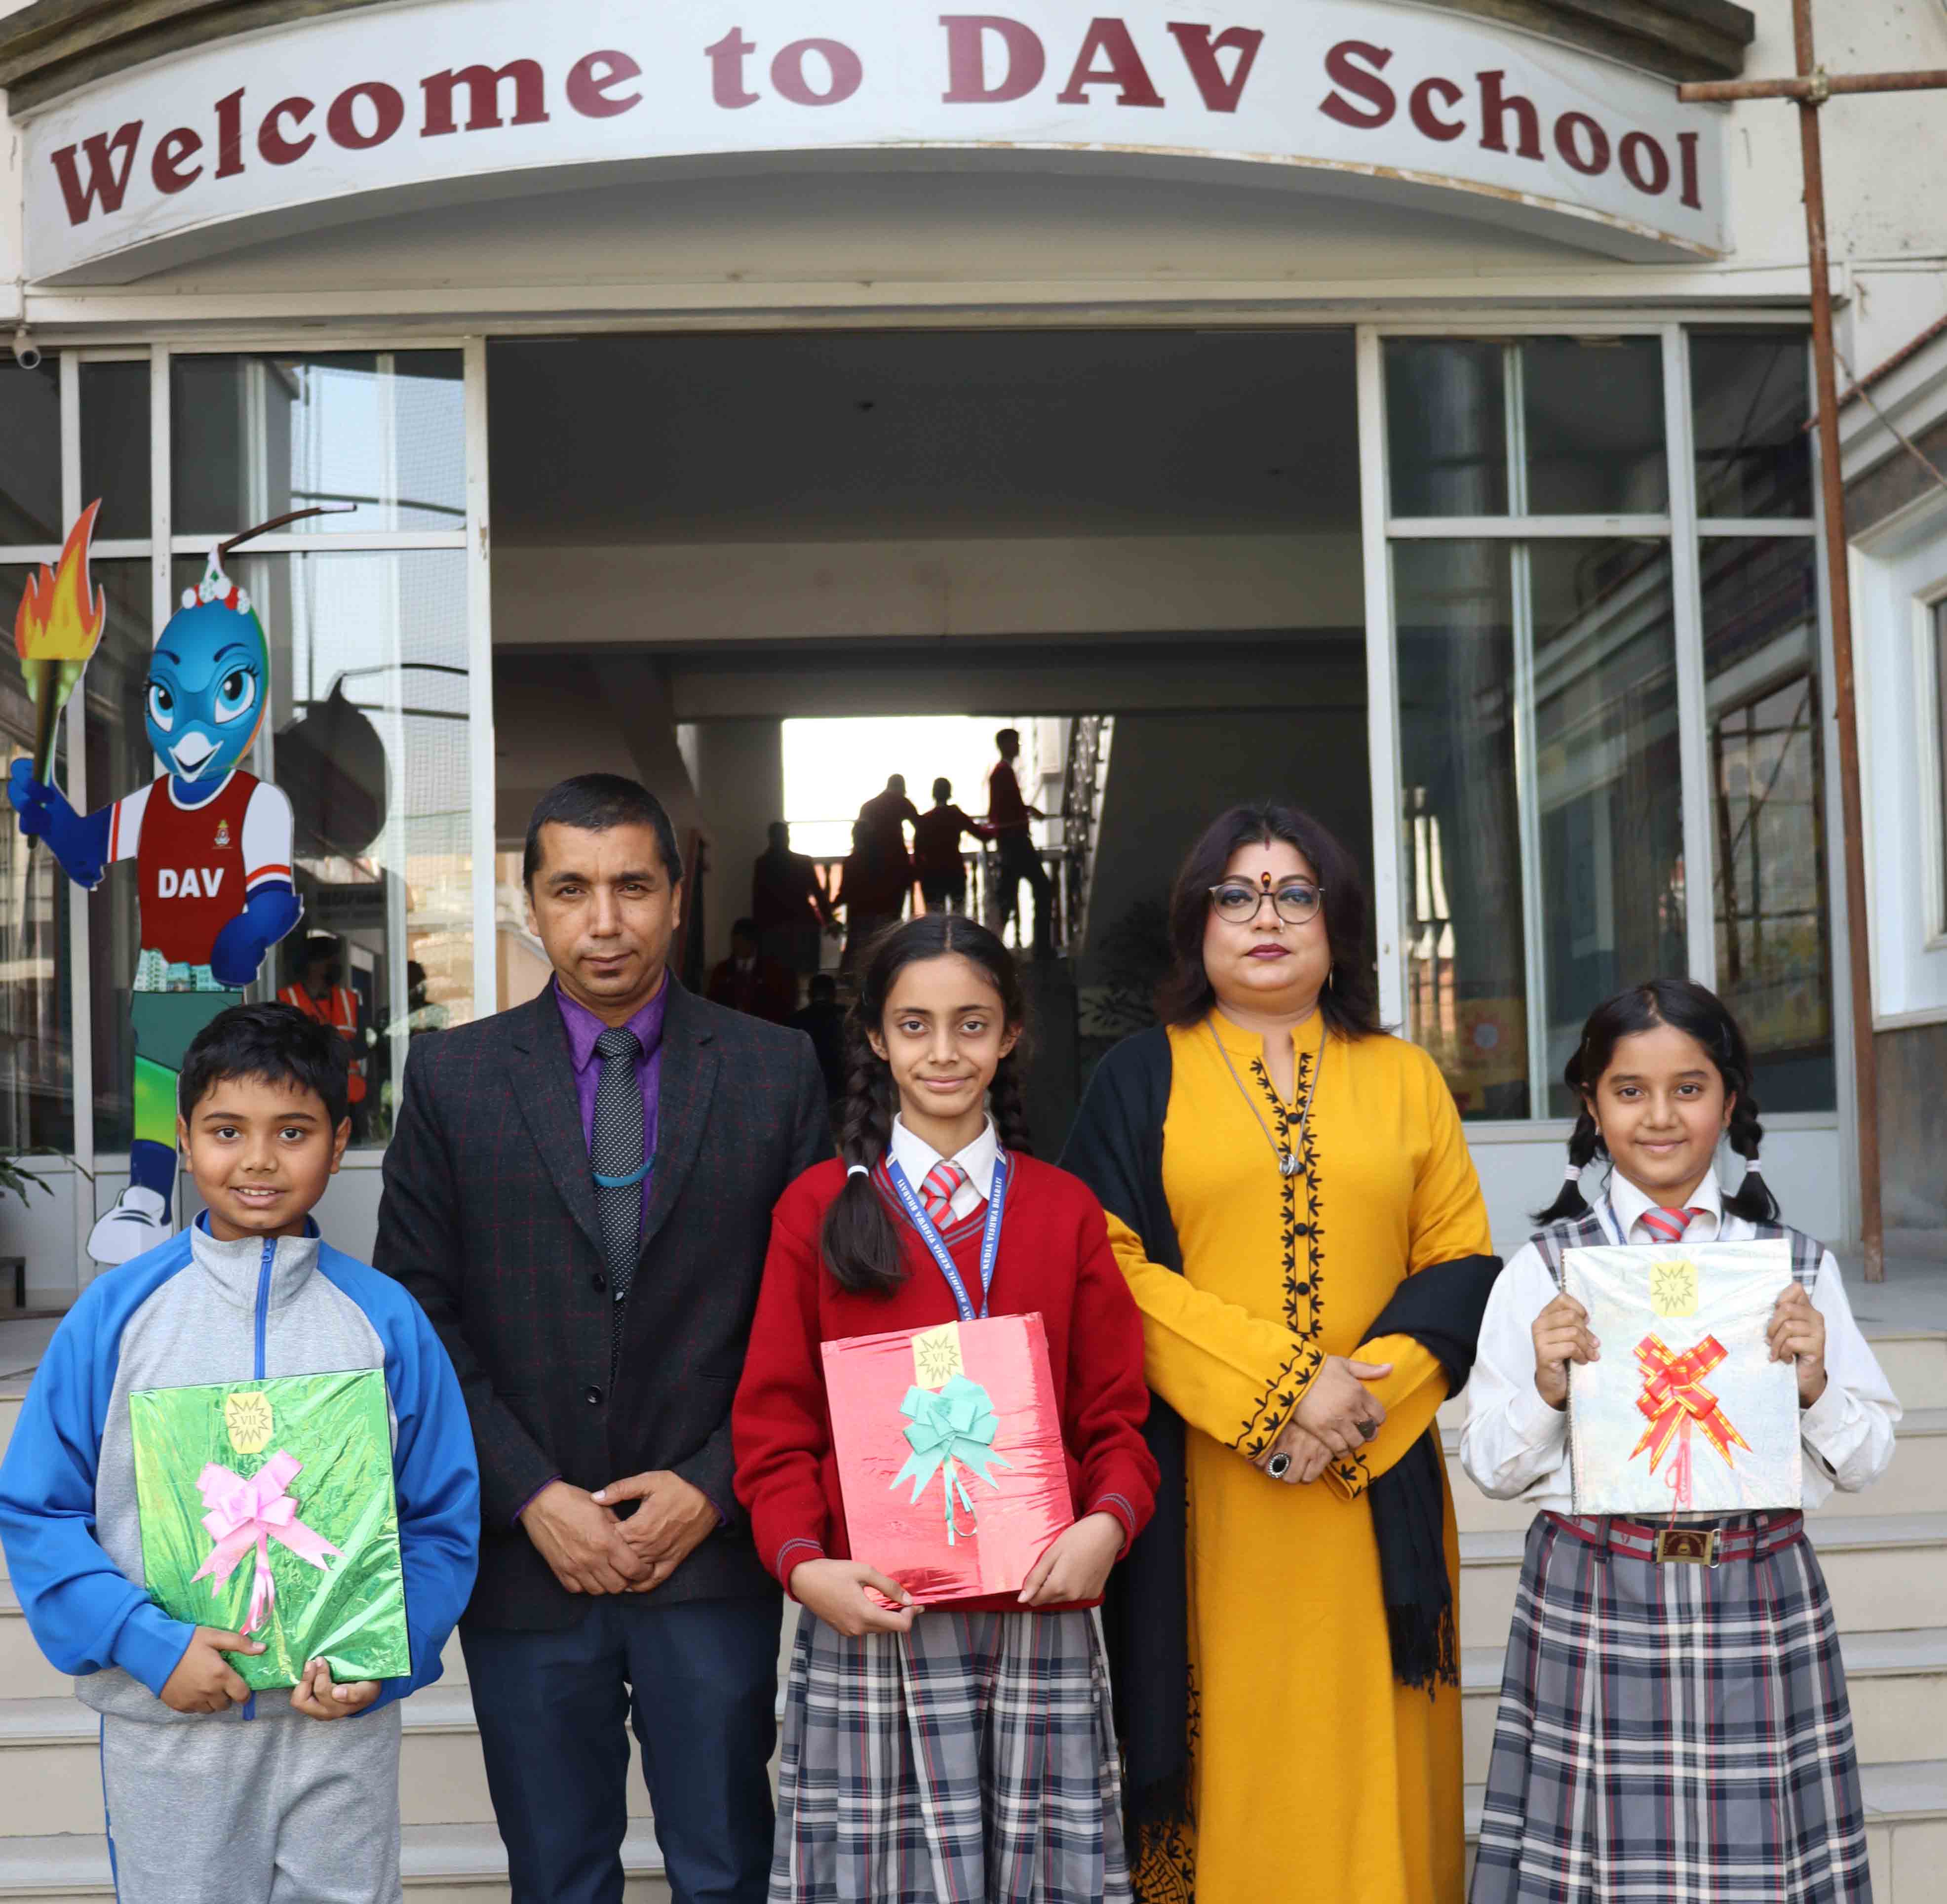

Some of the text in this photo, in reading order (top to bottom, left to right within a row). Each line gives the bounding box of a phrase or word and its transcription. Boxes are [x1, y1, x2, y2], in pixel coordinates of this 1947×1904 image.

[51, 15, 1703, 226] Welcome to DAV School
[158, 868, 224, 898] DAV
[897, 1179, 918, 1211] BHARATI
[915, 1211, 935, 1243] VISHWA
[987, 1210, 998, 1241] VISHWA
[934, 1244, 951, 1269] KEDIA
[983, 1243, 993, 1269] KEDIA
[240, 1415, 256, 1425] VII
